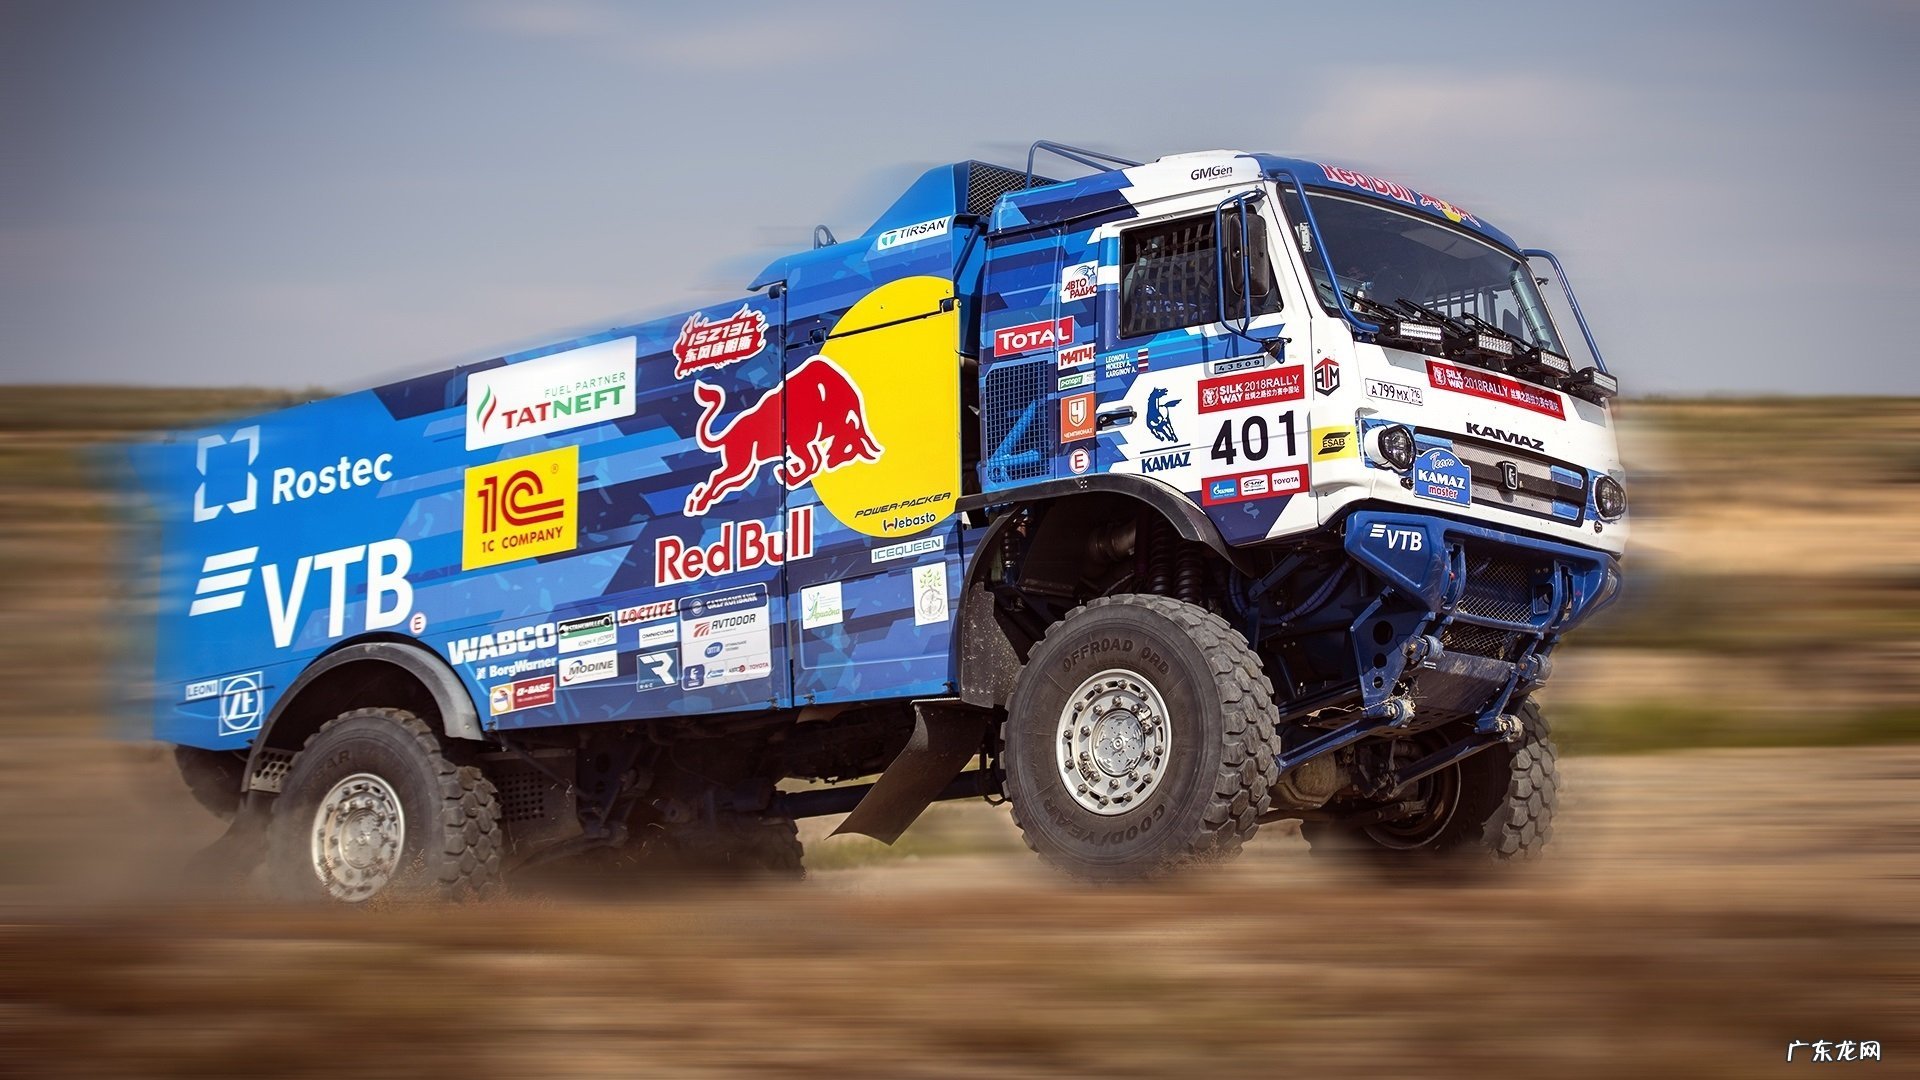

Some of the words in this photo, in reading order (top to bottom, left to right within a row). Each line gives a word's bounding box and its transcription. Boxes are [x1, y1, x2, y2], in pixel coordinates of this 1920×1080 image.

[1191, 164, 1233, 181] GMGen
[900, 219, 946, 239] TIRSAN
[1064, 278, 1087, 292] АВТО
[1069, 284, 1097, 299] РАДИО
[998, 327, 1070, 351] TOTAL
[1106, 354, 1125, 364] LEONOV
[1106, 362, 1124, 371] MOKEEV
[1218, 360, 1261, 372] 43509
[1106, 369, 1130, 378] KARGINOV
[545, 385, 571, 398] FUEL
[575, 372, 626, 394] PARTNER
[1219, 382, 1243, 395] SILK
[1447, 378, 1464, 390] WAY
[501, 385, 626, 429] TATNEFT
[1220, 392, 1244, 405] WAY
[1210, 410, 1297, 466] 401
[1322, 438, 1345, 448] ESAB
[1466, 422, 1545, 453] KAMAZ
[1074, 453, 1085, 469] E
[1141, 452, 1191, 474] KAMAZ
[1429, 451, 1455, 470] Team
[272, 453, 393, 505] Rostec
[1274, 477, 1298, 485] TOYOTA
[1418, 469, 1466, 490] KAMAZ
[1428, 485, 1458, 499] master
[855, 492, 951, 518] POWER-PACKER
[883, 512, 936, 532] Webasto
[482, 541, 495, 553] 1C
[502, 526, 563, 550] COMPANY
[657, 524, 731, 585] Red
[738, 508, 812, 569] Bull
[874, 539, 941, 560] ICEQUEEN
[1387, 530, 1422, 551] VTB
[260, 538, 414, 649] VTB
[620, 602, 673, 624] LOCTITE
[712, 613, 756, 630] AVTODOR
[413, 617, 422, 630] E
[447, 622, 557, 665] WABCO
[1062, 638, 1134, 673] OFFROAD
[1140, 648, 1170, 676] ORD
[489, 657, 557, 678] BorgWarner
[568, 660, 614, 676] MODINE
[187, 683, 217, 697] LEONI
